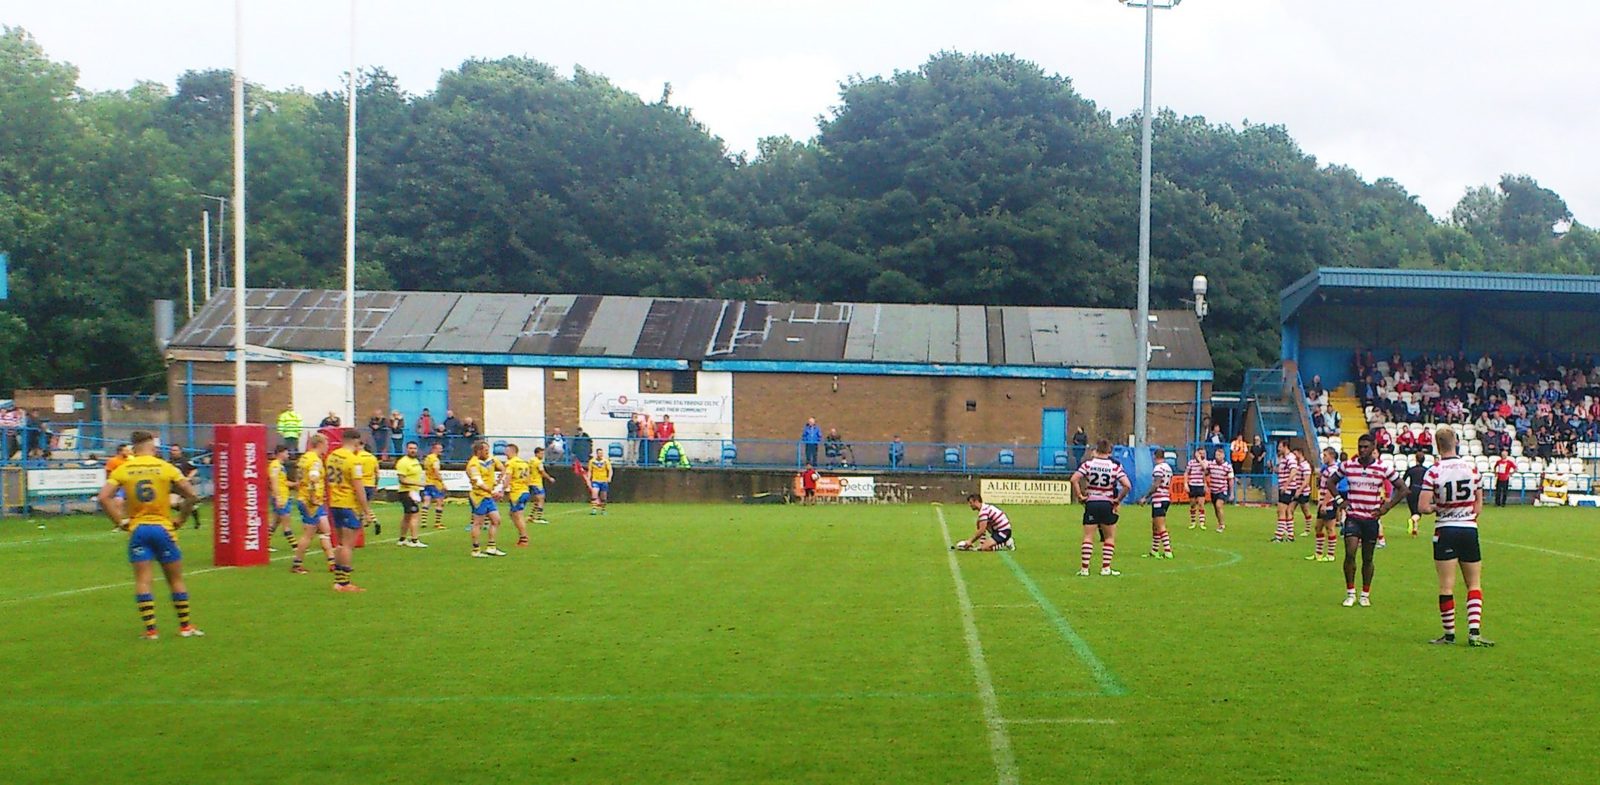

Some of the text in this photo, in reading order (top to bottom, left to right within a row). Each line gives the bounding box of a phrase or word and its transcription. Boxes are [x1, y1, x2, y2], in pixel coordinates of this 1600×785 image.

[135, 479, 157, 503] 6
[987, 481, 1068, 492] ALKIE LIMITED
[1089, 472, 1111, 487] 23
[1443, 479, 1472, 502] 15
[243, 443, 261, 550] Kingstone Press
